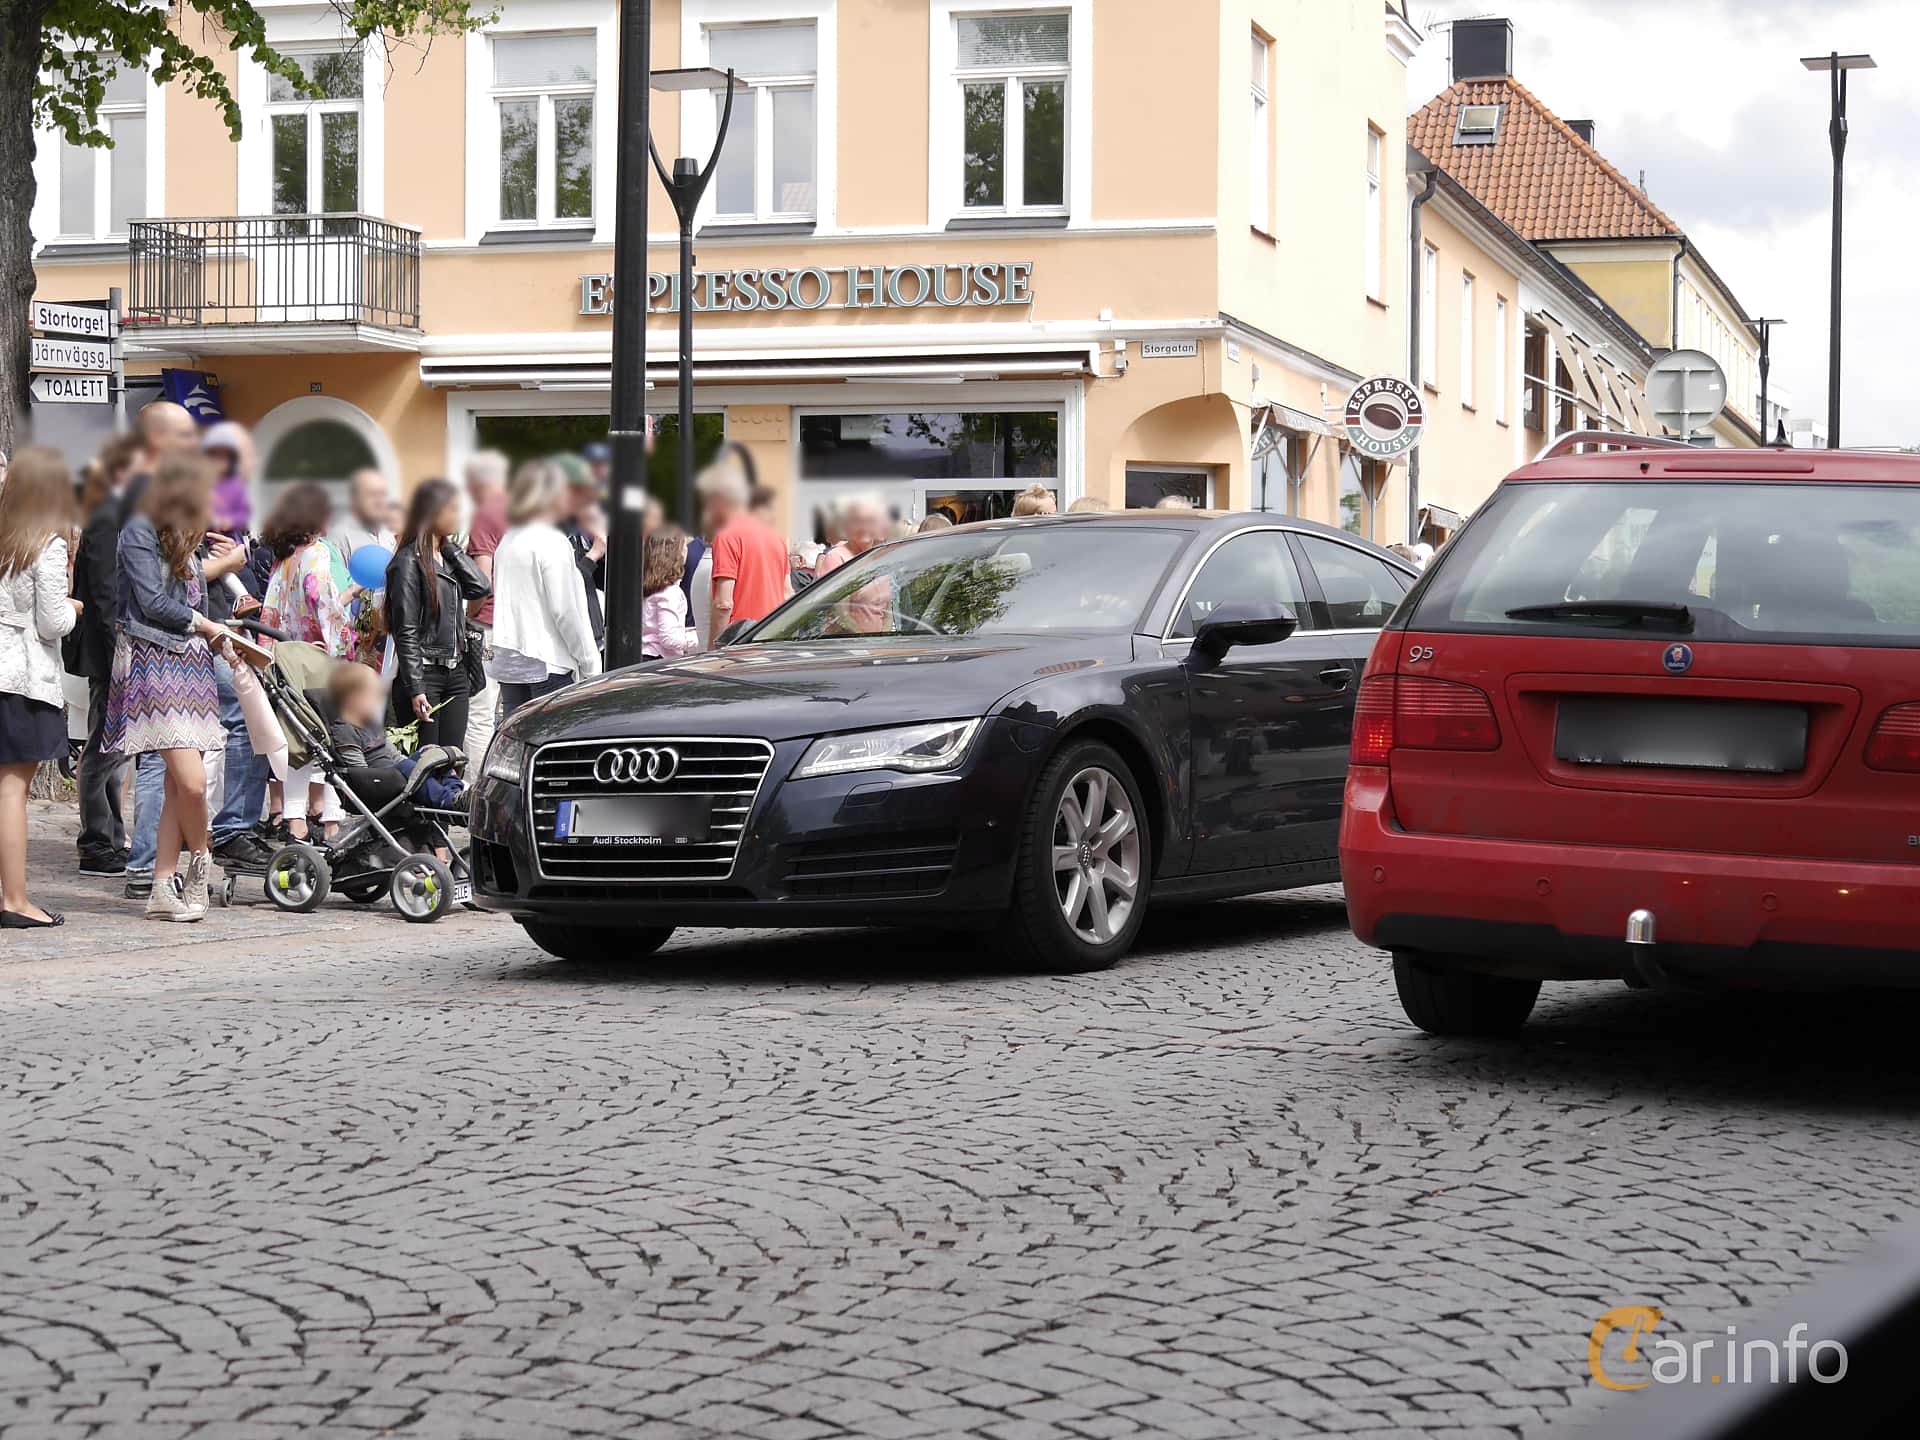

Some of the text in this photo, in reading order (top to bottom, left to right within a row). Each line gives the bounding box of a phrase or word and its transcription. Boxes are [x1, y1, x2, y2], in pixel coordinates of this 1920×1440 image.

[578, 261, 1033, 315] EPRESSO HOUSE
[39, 307, 104, 334] Stortorget
[34, 343, 109, 369] Järnvägsg.
[1144, 344, 1194, 354] Storgatan
[44, 379, 104, 397] TOALETT
[1349, 379, 1419, 411] ESPRESSO
[1356, 433, 1412, 453] HOUSE
[1409, 645, 1433, 663] 95
[592, 836, 662, 845] Audi Stockholm
